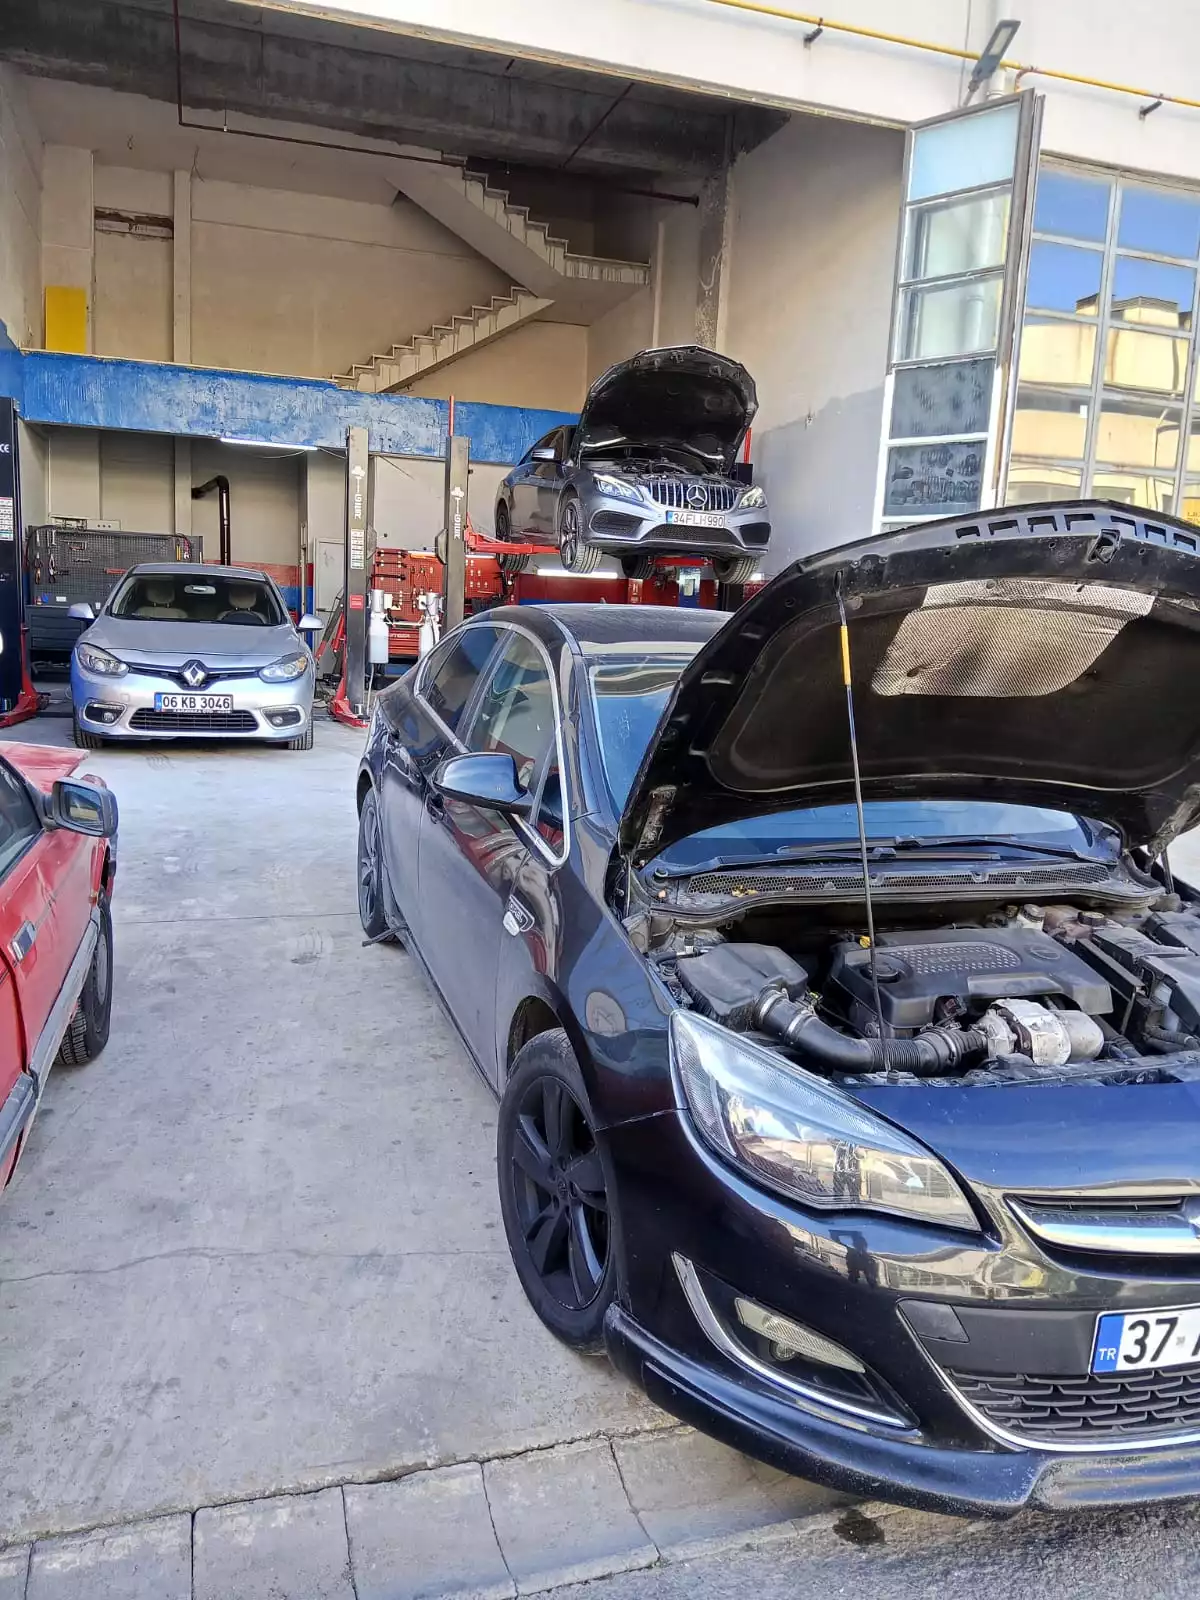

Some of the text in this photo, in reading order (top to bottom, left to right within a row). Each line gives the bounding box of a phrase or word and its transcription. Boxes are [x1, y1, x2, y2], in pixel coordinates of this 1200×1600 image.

[162, 696, 230, 709] 06 KB 3046
[1098, 1347, 1117, 1361] TR
[1123, 1316, 1179, 1365] 37
